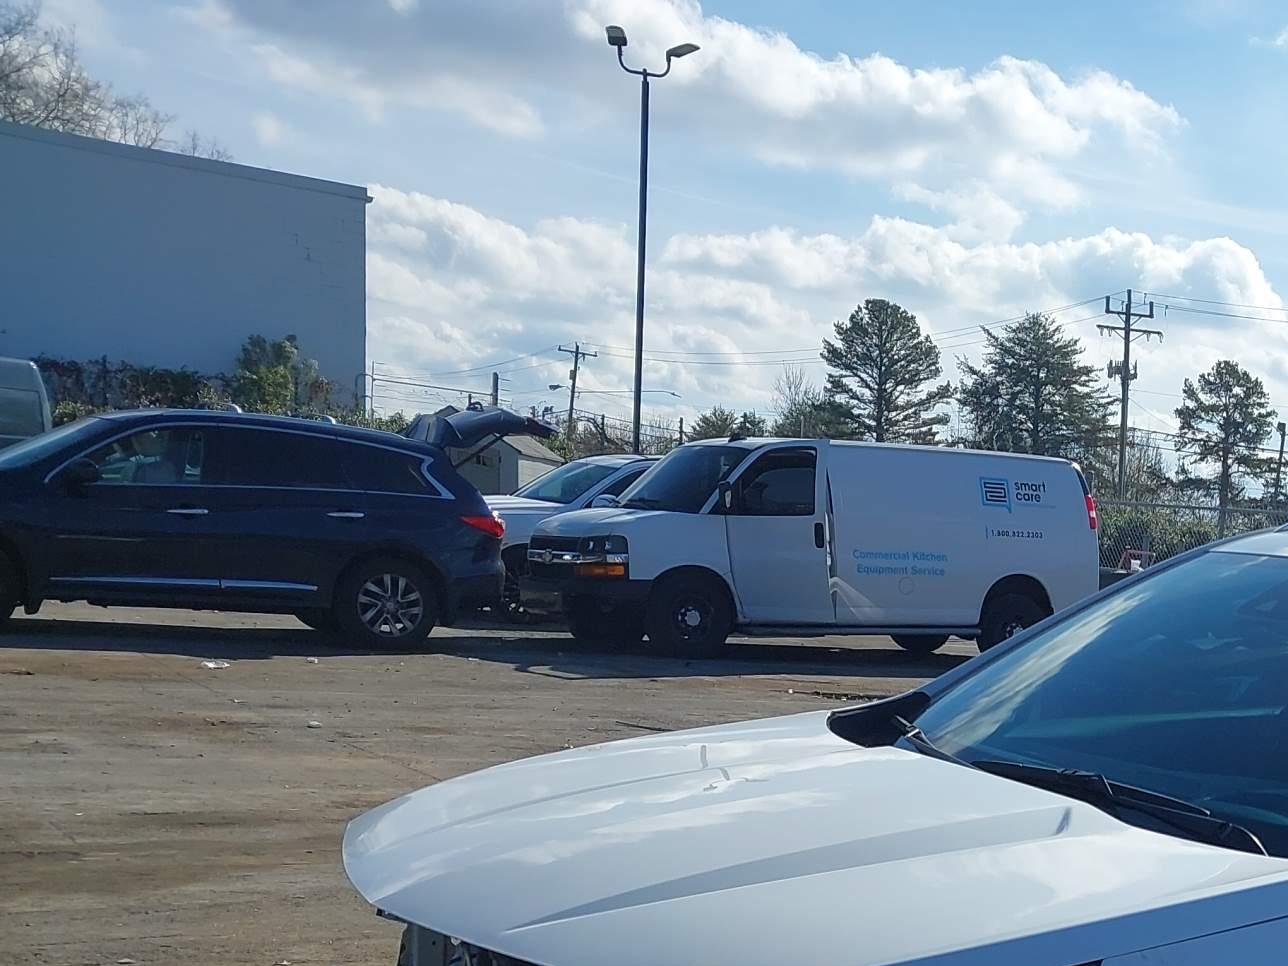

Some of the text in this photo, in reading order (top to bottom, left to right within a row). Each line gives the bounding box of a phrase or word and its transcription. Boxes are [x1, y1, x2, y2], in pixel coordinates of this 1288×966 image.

[1014, 481, 1046, 493] smart
[1016, 492, 1041, 503] care
[852, 549, 948, 562] Commercial Kitchen
[856, 563, 945, 577] Equipment Service
